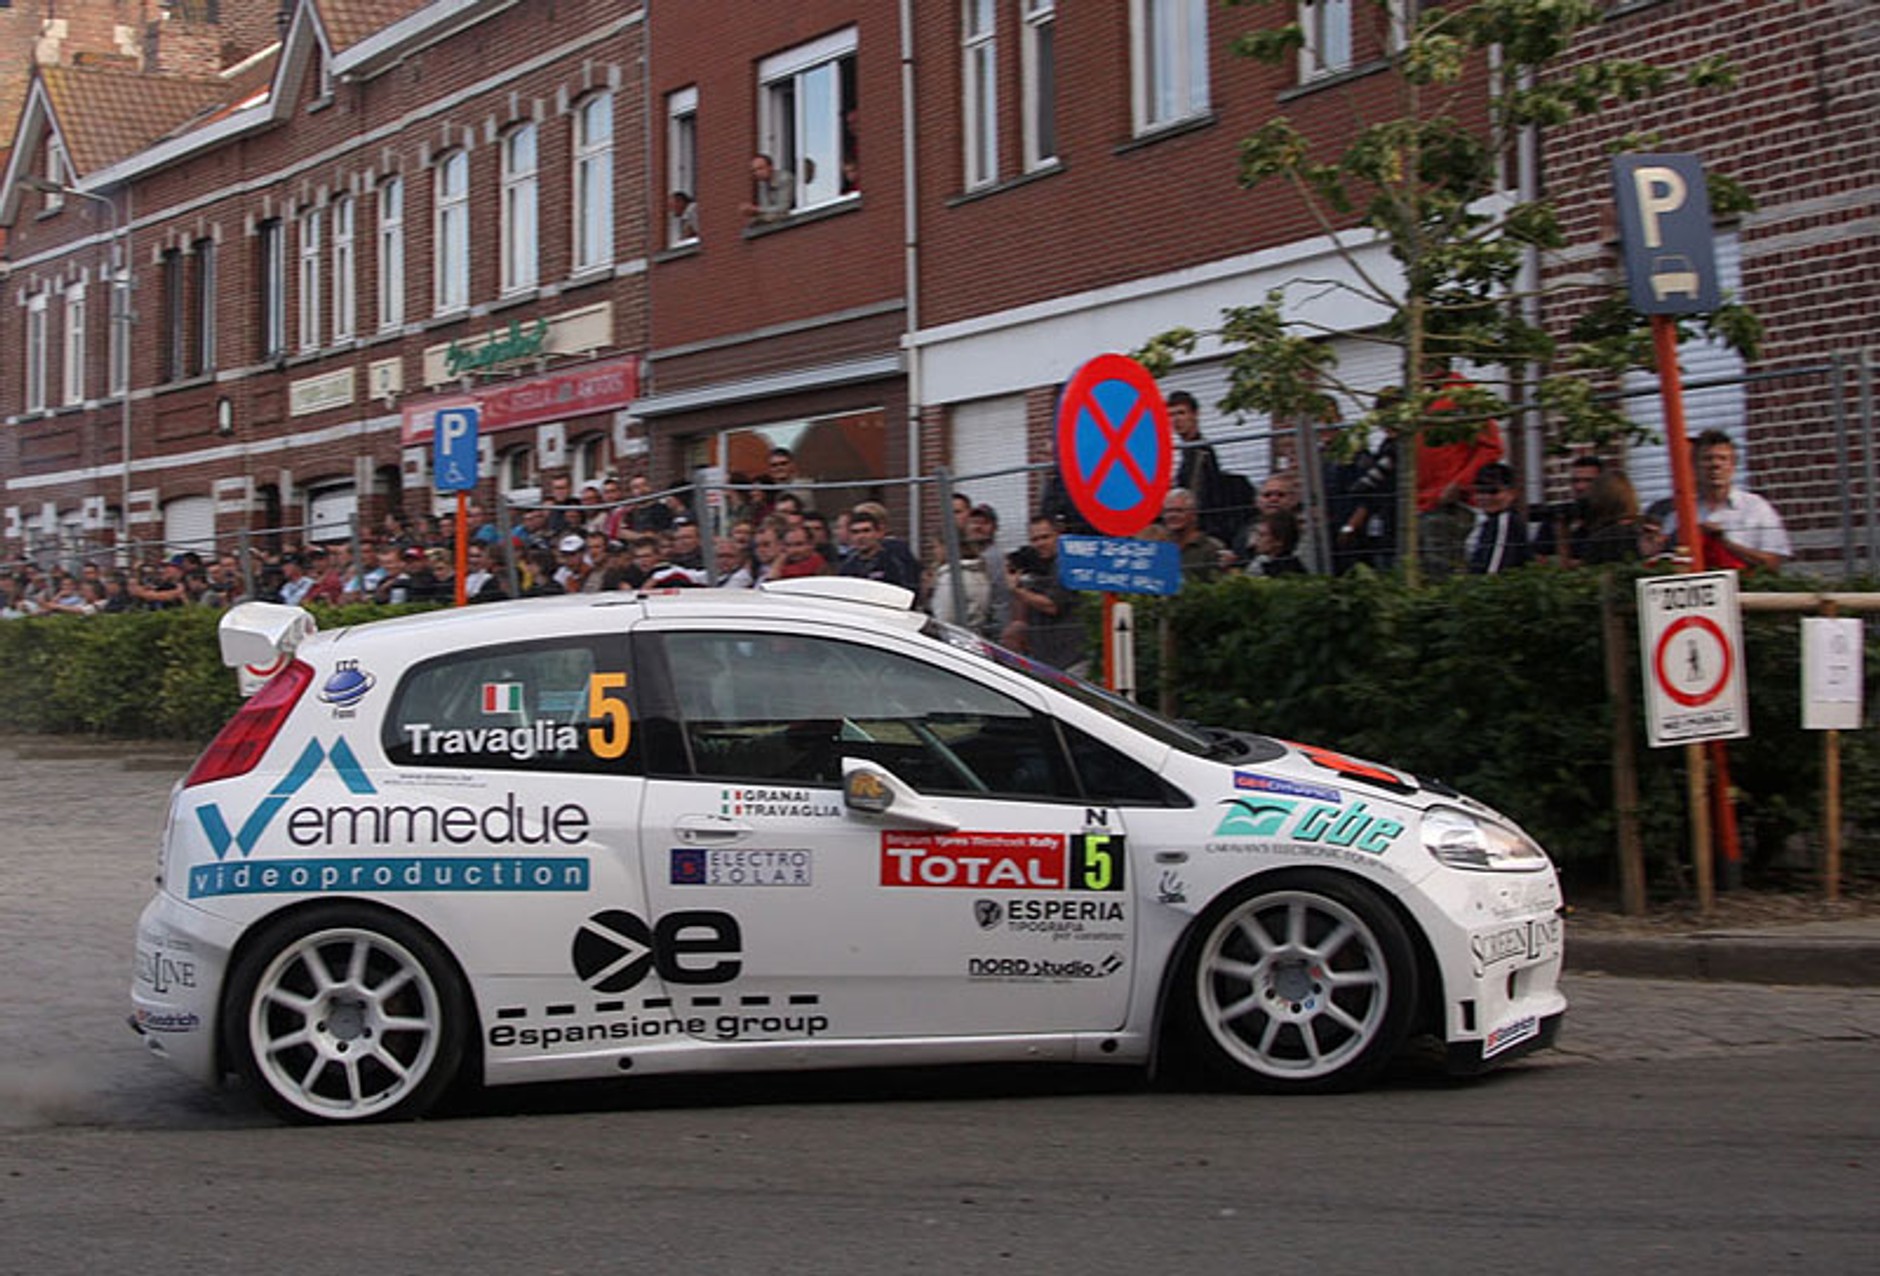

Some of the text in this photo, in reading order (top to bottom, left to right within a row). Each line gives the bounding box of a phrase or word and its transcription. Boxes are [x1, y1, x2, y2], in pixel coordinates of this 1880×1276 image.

[1633, 166, 1688, 248] P
[441, 413, 468, 456] P
[404, 672, 631, 760] Travaglia 5
[743, 789, 810, 801] GRANAI
[287, 792, 590, 845] emmedue
[743, 804, 841, 817] TRAVAGLIA
[1086, 808, 1108, 825] N
[710, 852, 806, 867] ELECTRO
[887, 848, 1059, 886] TOTAL
[1084, 834, 1112, 890] 5
[195, 862, 583, 890] videoproduction
[710, 868, 806, 883] SOLAR
[1007, 901, 1125, 921] ESPERIA
[1008, 921, 1084, 932] TIPOGRAFIA
[1033, 958, 1095, 977] studio
[488, 1013, 829, 1049] espansione group
